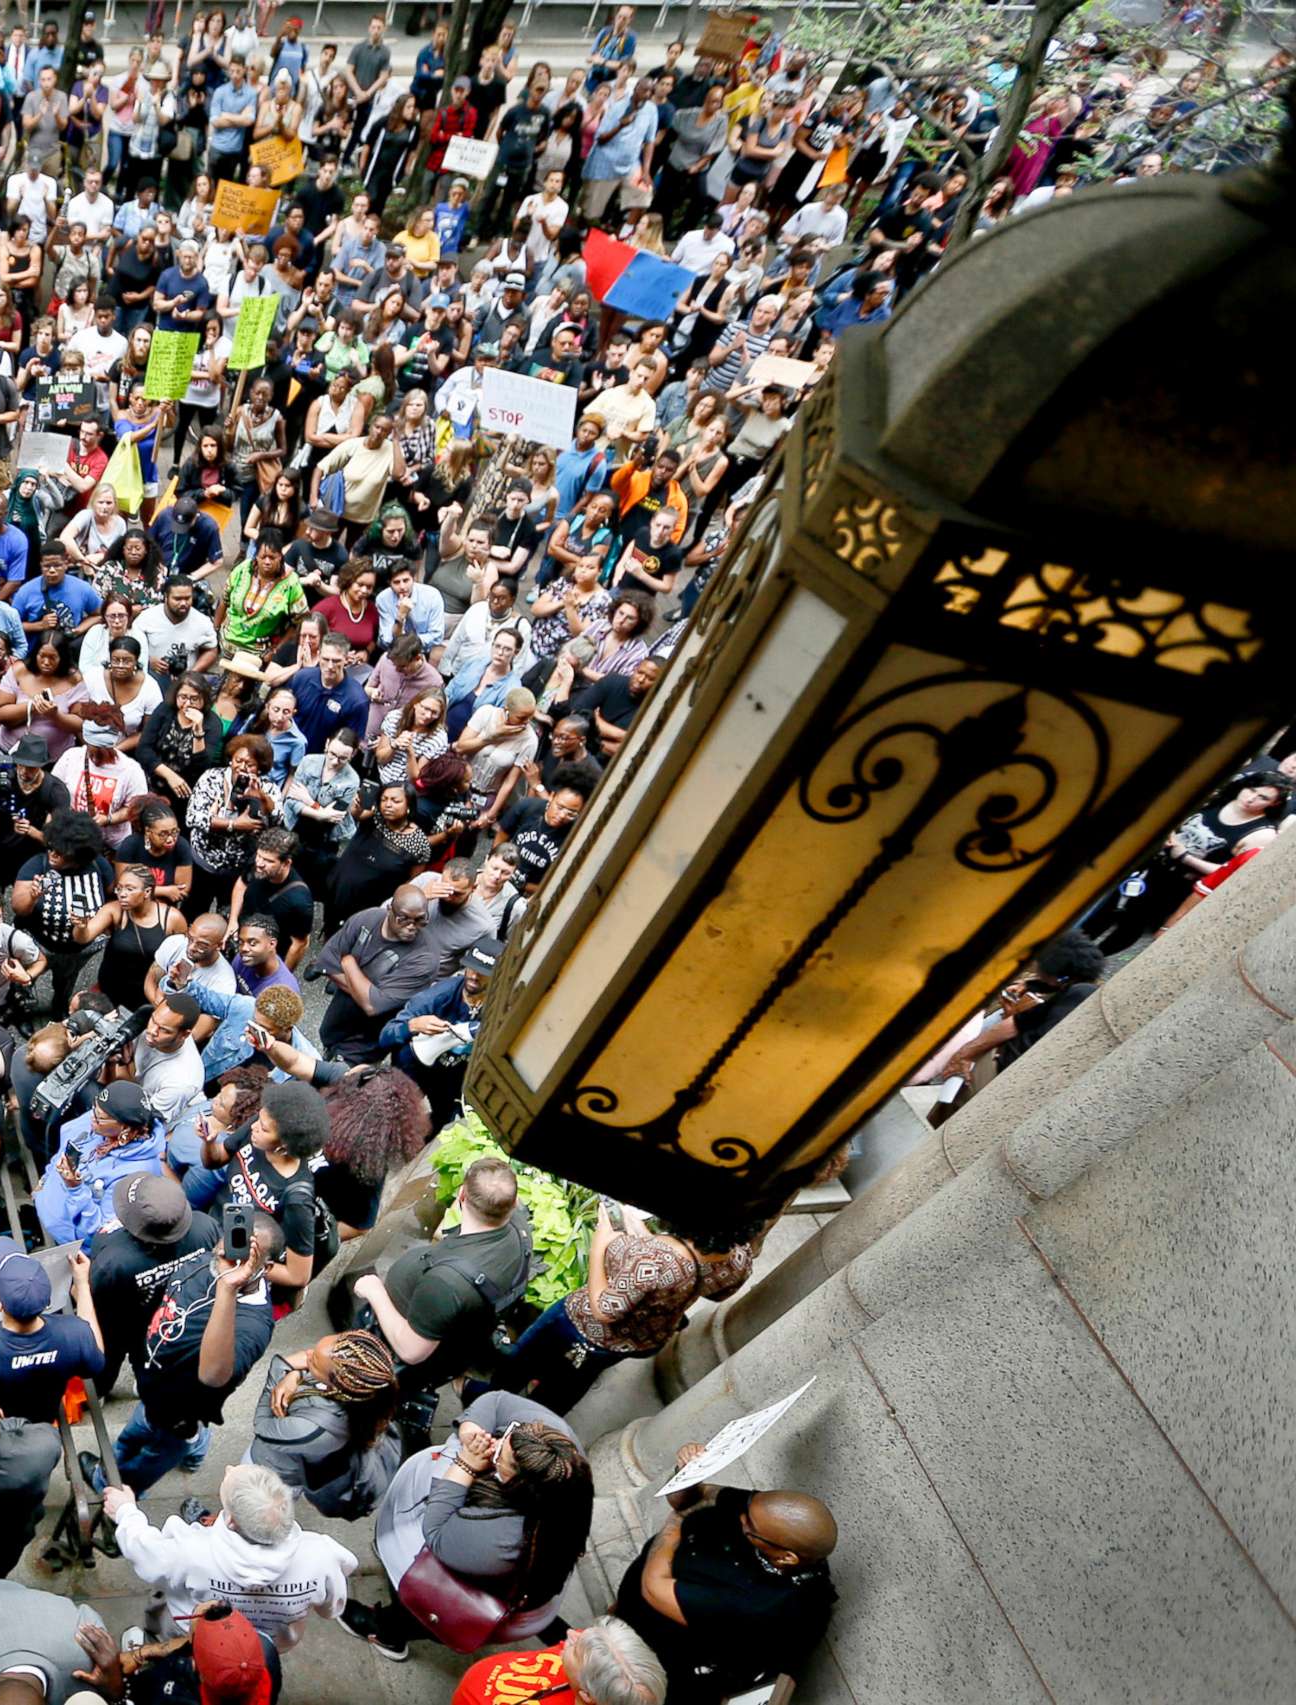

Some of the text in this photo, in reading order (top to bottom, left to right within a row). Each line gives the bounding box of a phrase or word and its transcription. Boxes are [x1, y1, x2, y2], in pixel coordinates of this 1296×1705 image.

[489, 407, 524, 425] STOP
[136, 1275, 153, 1287] 10
[11, 1350, 58, 1369] UNITE!
[209, 1578, 233, 1591] THE
